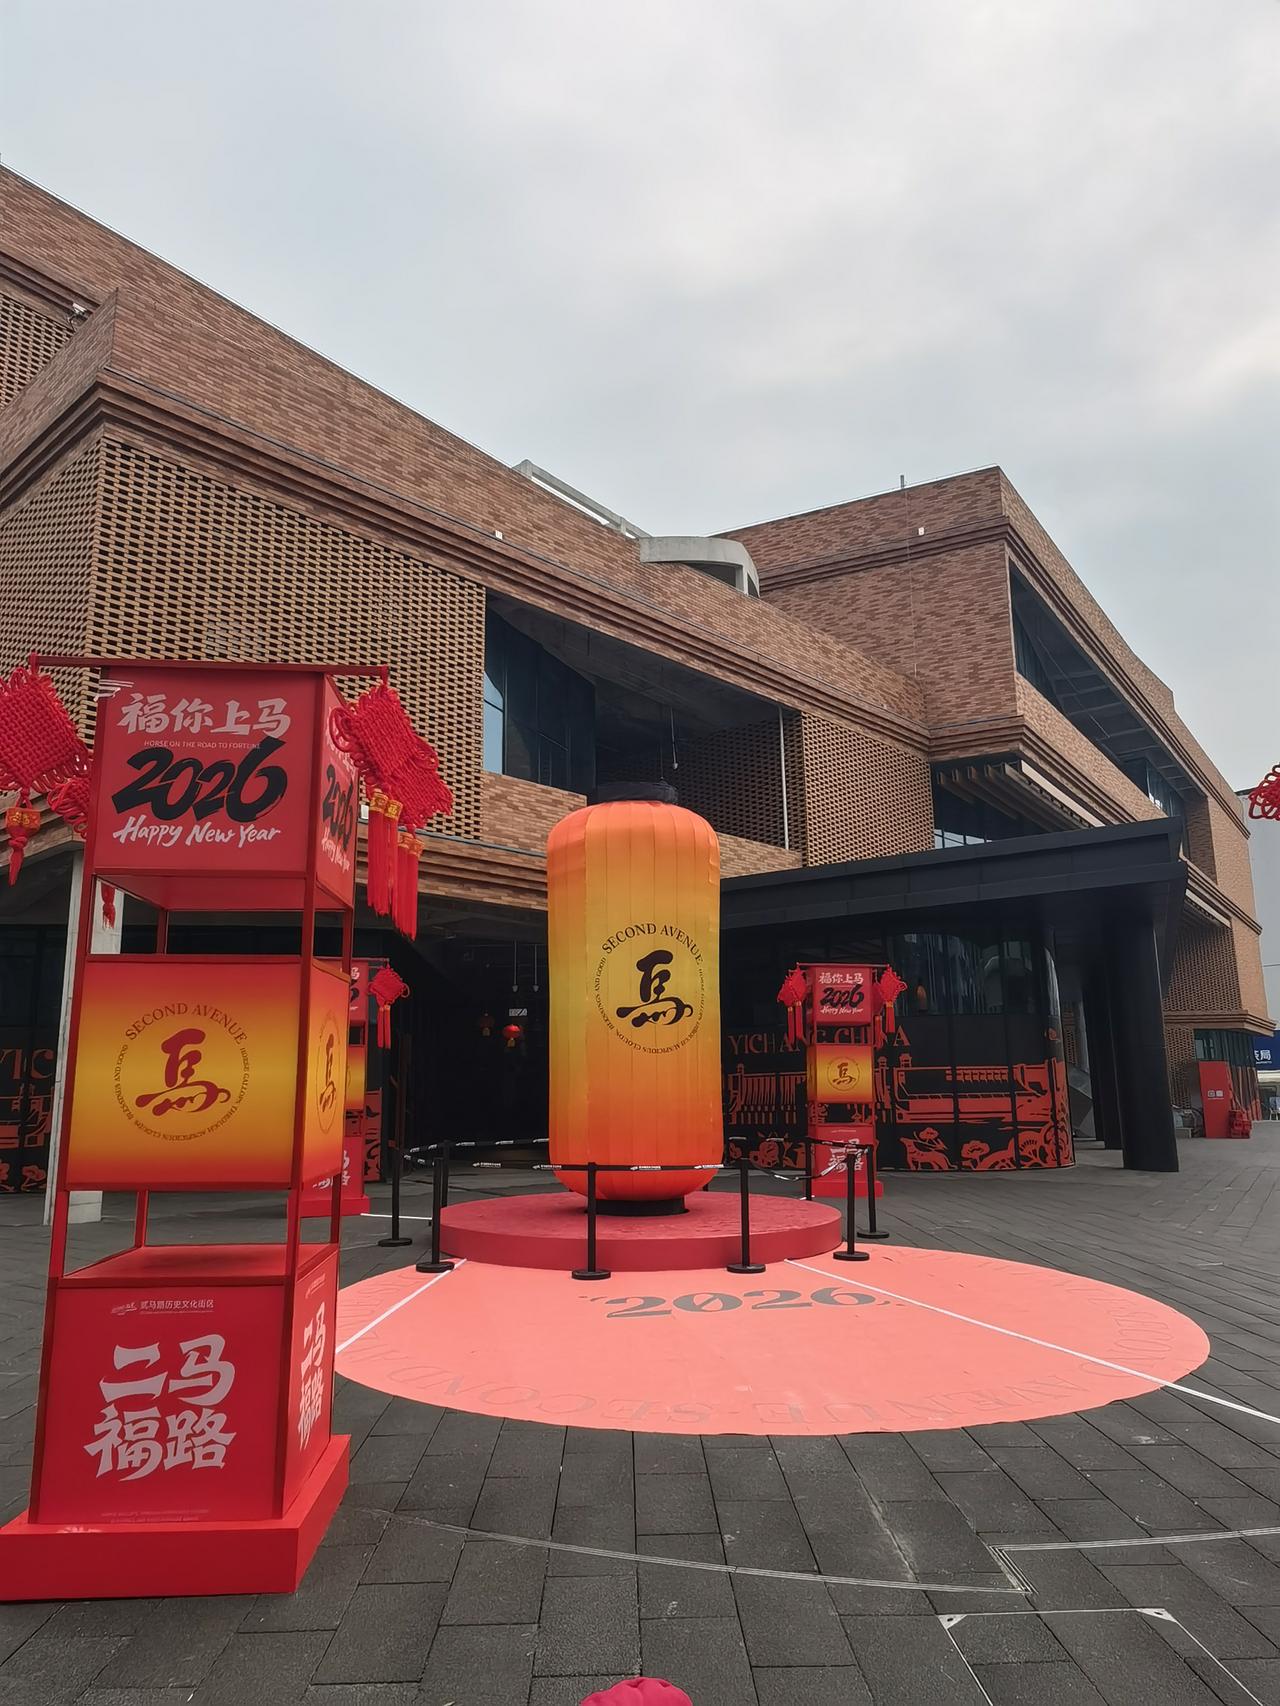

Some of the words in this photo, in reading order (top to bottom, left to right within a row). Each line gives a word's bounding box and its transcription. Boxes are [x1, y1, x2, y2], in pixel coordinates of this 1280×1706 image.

[117, 693, 291, 738] 福你上马
[144, 740, 168, 748] HORSE
[169, 740, 181, 748] ON
[197, 741, 217, 749] ROAD
[112, 736, 288, 823] 2026
[113, 814, 183, 847] Happy
[185, 821, 236, 846] New
[237, 824, 281, 848] Year
[602, 923, 657, 954] SECOND
[660, 925, 704, 965] AVENUE
[820, 984, 865, 1008] 2026
[125, 1002, 188, 1041] SECOND
[191, 1004, 248, 1045] AVENUE
